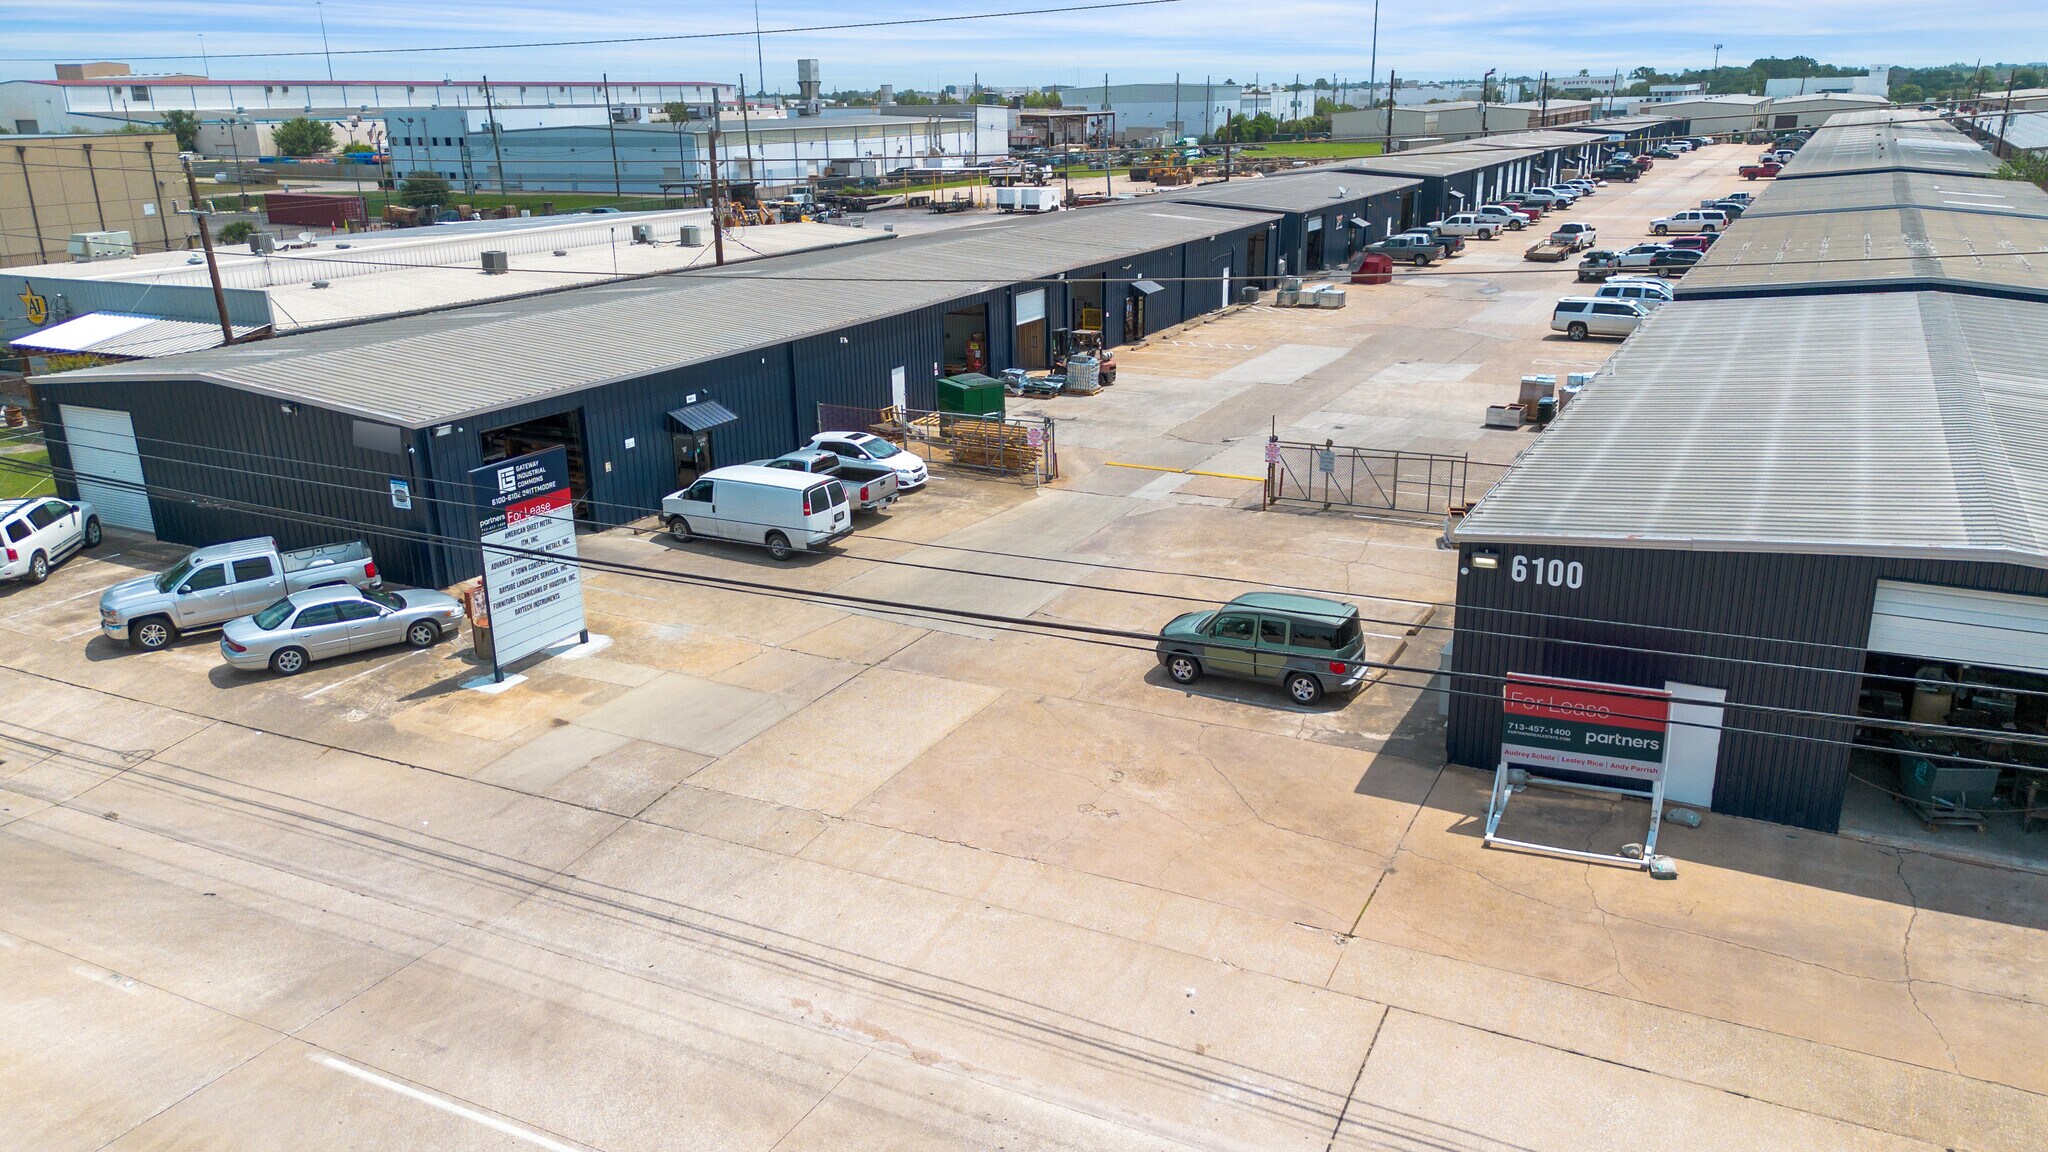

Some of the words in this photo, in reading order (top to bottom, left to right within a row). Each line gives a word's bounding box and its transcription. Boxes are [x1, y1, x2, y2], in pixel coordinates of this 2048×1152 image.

[516, 460, 539, 472] GATEWAY
[516, 466, 546, 480] INDUSTRIAL
[518, 475, 544, 488] COMMONS
[480, 514, 506, 528] partners
[508, 510, 522, 523] For
[524, 502, 551, 518] Lease
[504, 526, 526, 540] AMERICAN
[526, 523, 540, 532] SHEET
[540, 518, 553, 528] METAL
[491, 558, 513, 570] ADVANCED
[546, 540, 562, 552] METALS,
[511, 565, 528, 576] H-TOWN
[1511, 554, 1584, 590] 6100
[499, 582, 516, 594] BAYSIDE
[516, 574, 540, 588] LANDSCAPE
[493, 594, 516, 610] FURNITURE
[516, 586, 543, 601] TECHNICIANS
[533, 592, 561, 609] INSTRUMENTS
[1510, 692, 1544, 710] For
[1549, 696, 1610, 719] Lease
[1508, 722, 1571, 737] 713-457-1400
[1585, 732, 1660, 750] partners
[1504, 748, 1530, 760] Audrey
[1531, 752, 1556, 761] Scholz
[1561, 756, 1586, 767] Lesley
[1586, 759, 1604, 767] Rice
[1610, 762, 1630, 772] Andy
[1630, 765, 1658, 774] Parrish
